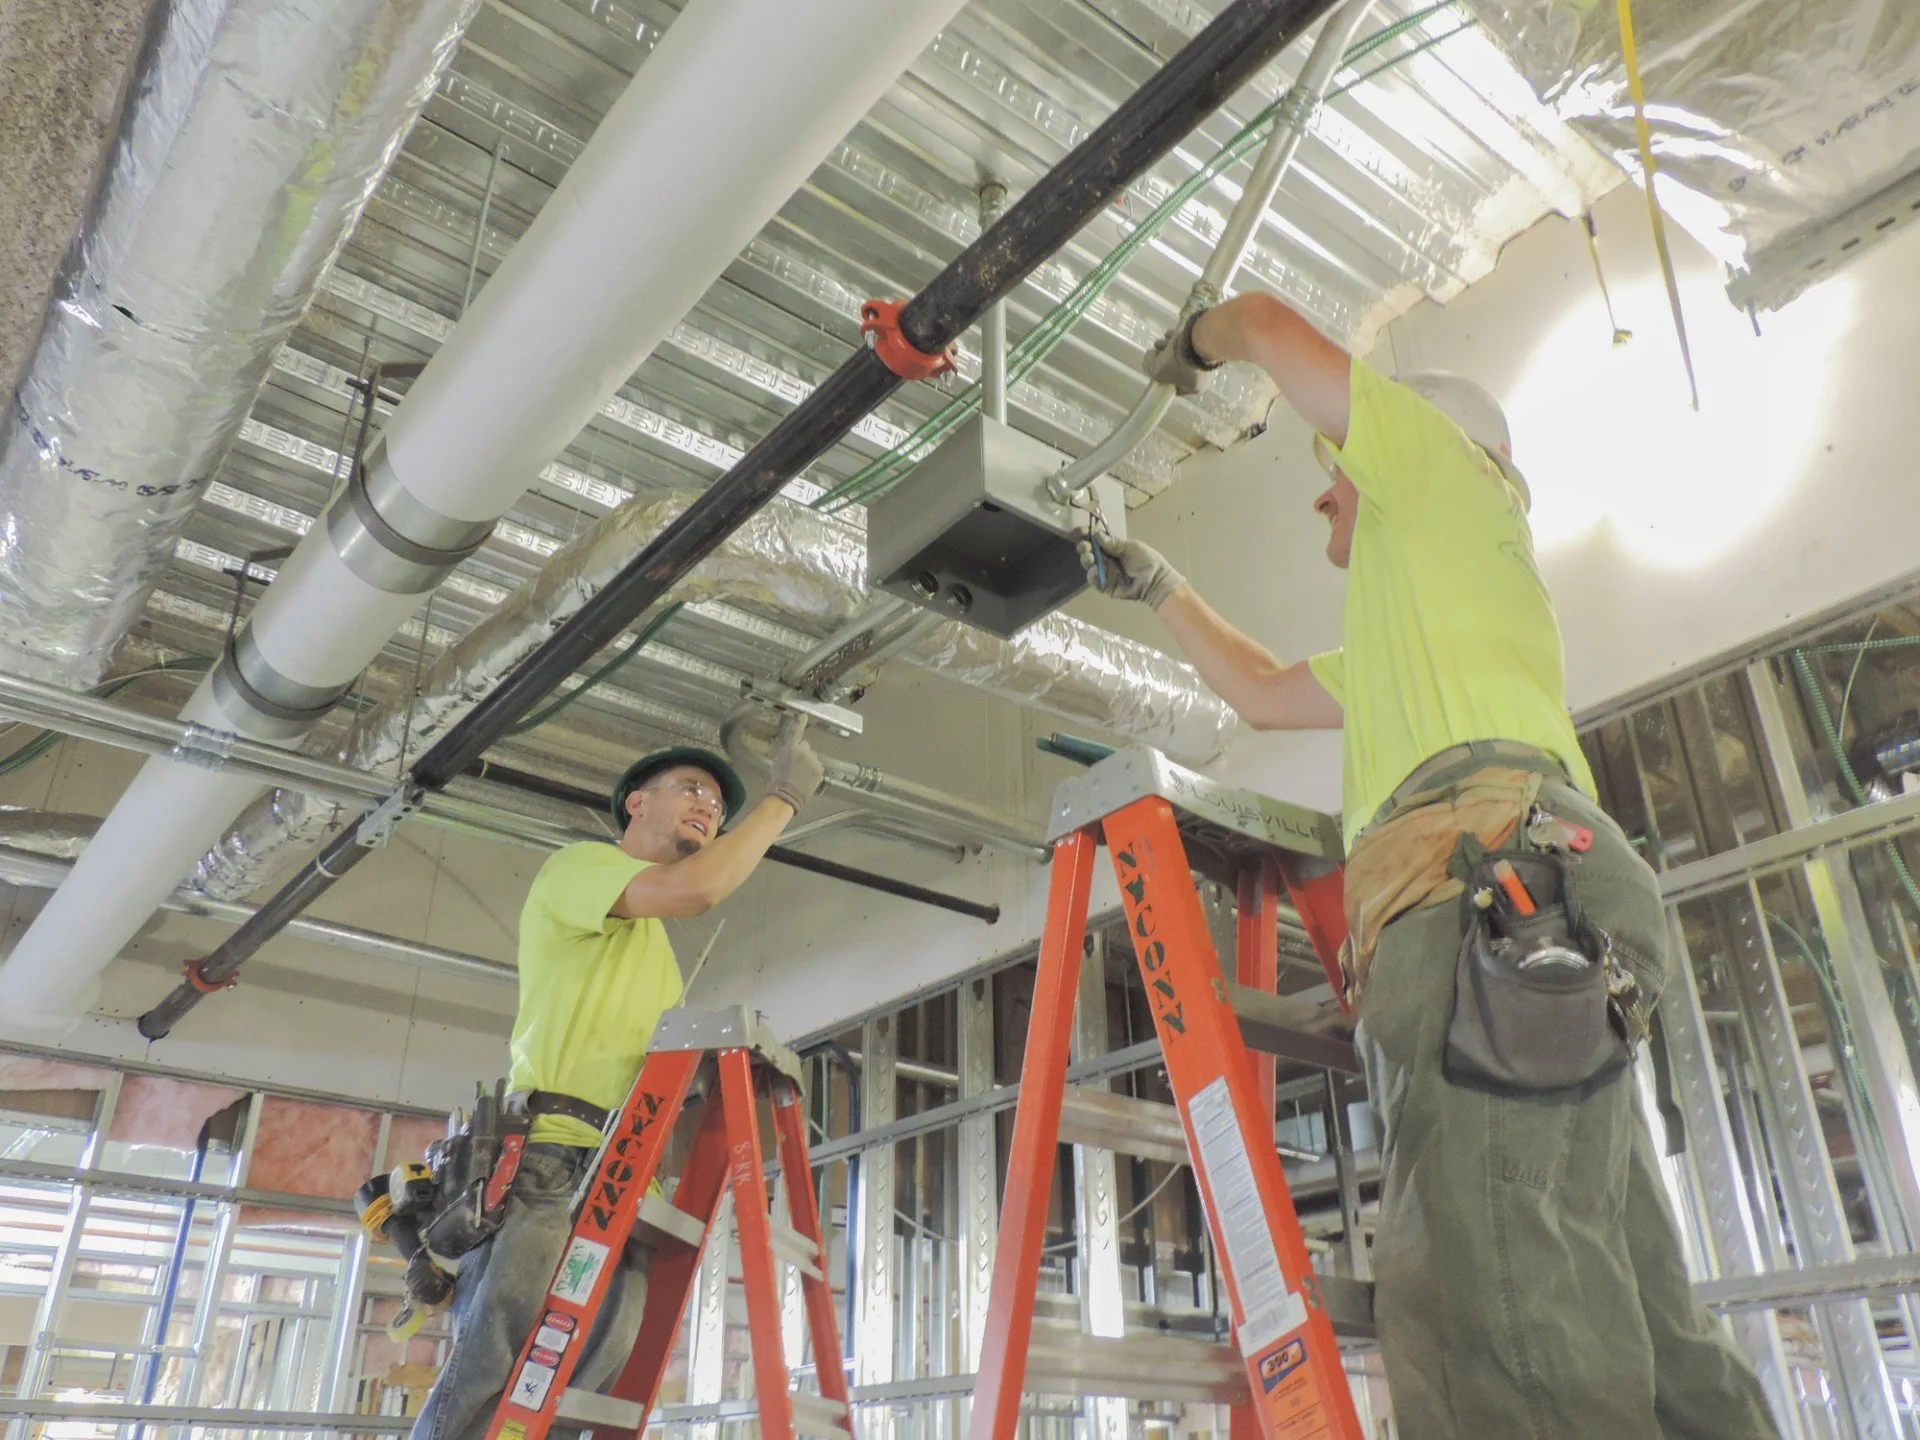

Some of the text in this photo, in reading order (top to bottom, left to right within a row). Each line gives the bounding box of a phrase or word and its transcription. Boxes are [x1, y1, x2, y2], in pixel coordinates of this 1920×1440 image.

[1190, 783, 1324, 841] LOUISVILLE
[1117, 840, 1186, 1044] NYCONN
[584, 1091, 664, 1231] NYCONN
[1267, 1351, 1289, 1372] 300
